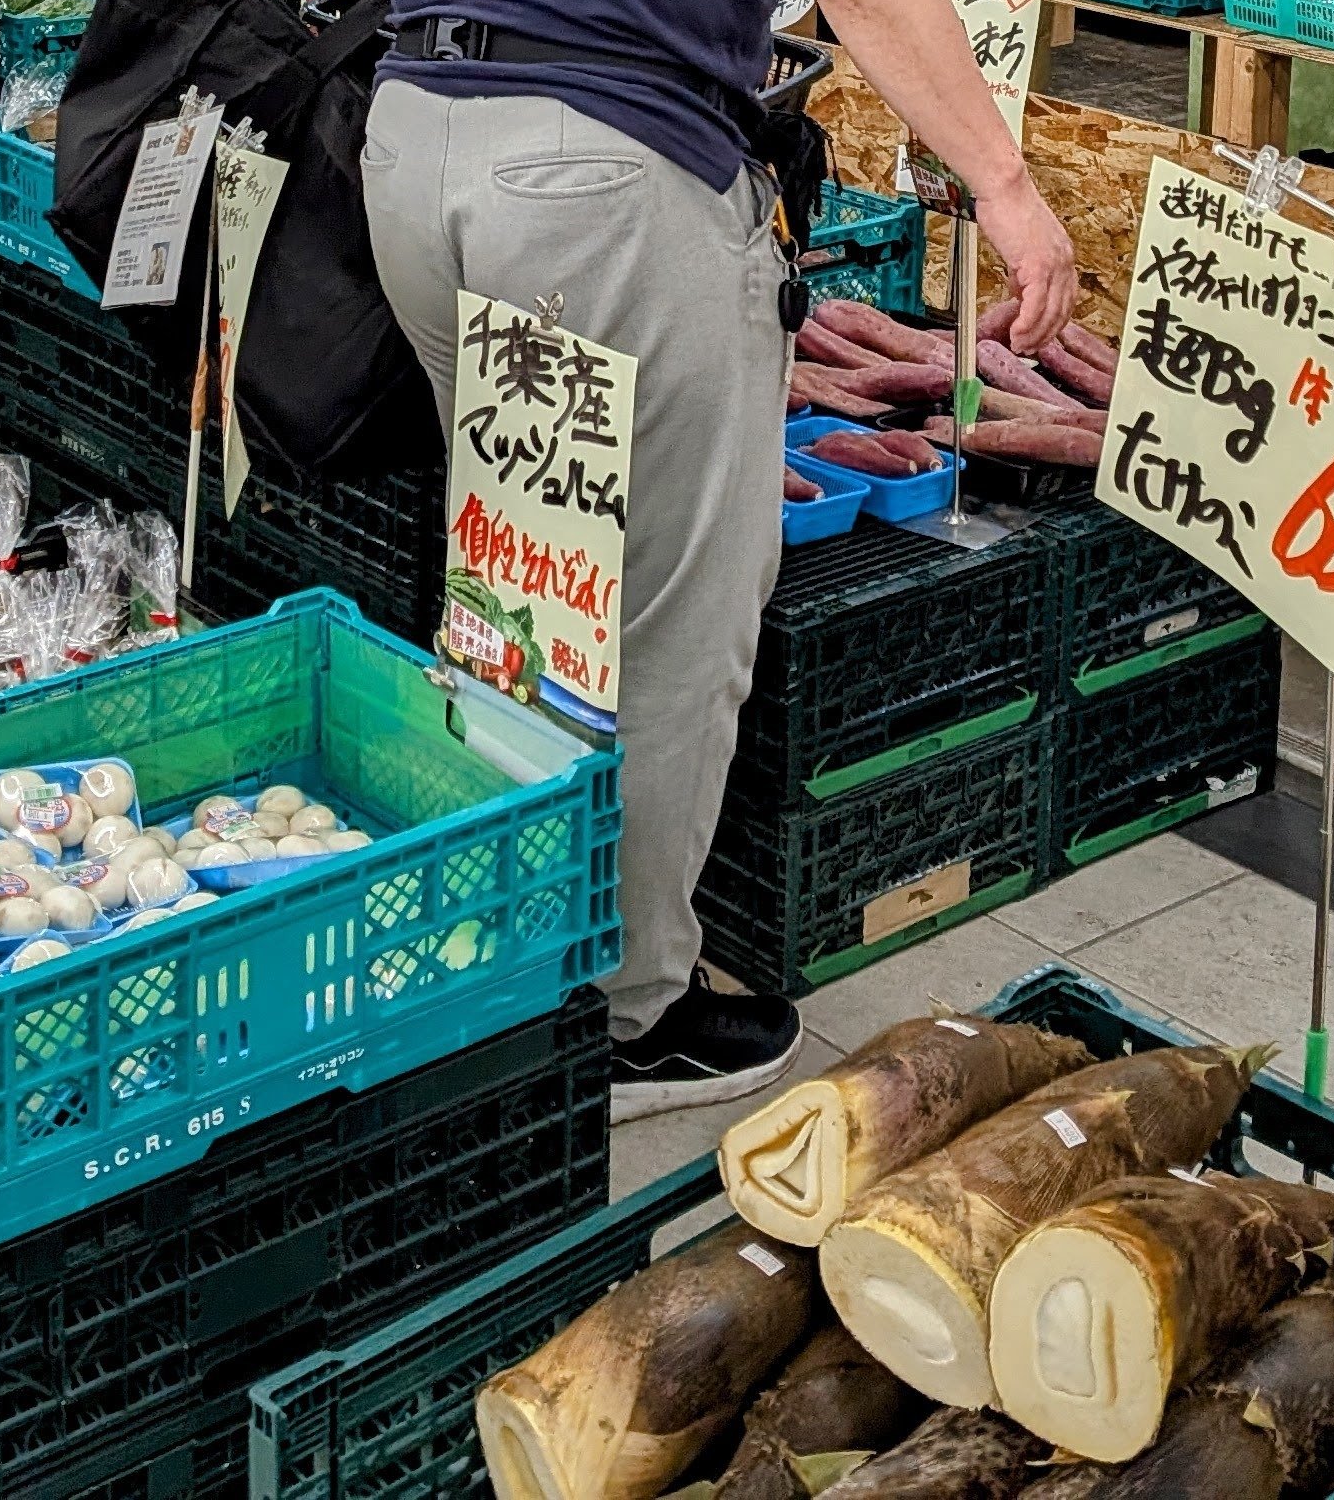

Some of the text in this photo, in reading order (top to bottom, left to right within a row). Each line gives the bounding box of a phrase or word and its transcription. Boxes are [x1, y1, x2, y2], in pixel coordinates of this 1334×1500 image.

[462, 300, 621, 450] 千葉産
[551, 636, 611, 695] 税込!
[83, 1133, 174, 1181] S.C.R.
[186, 1107, 227, 1141] 615
